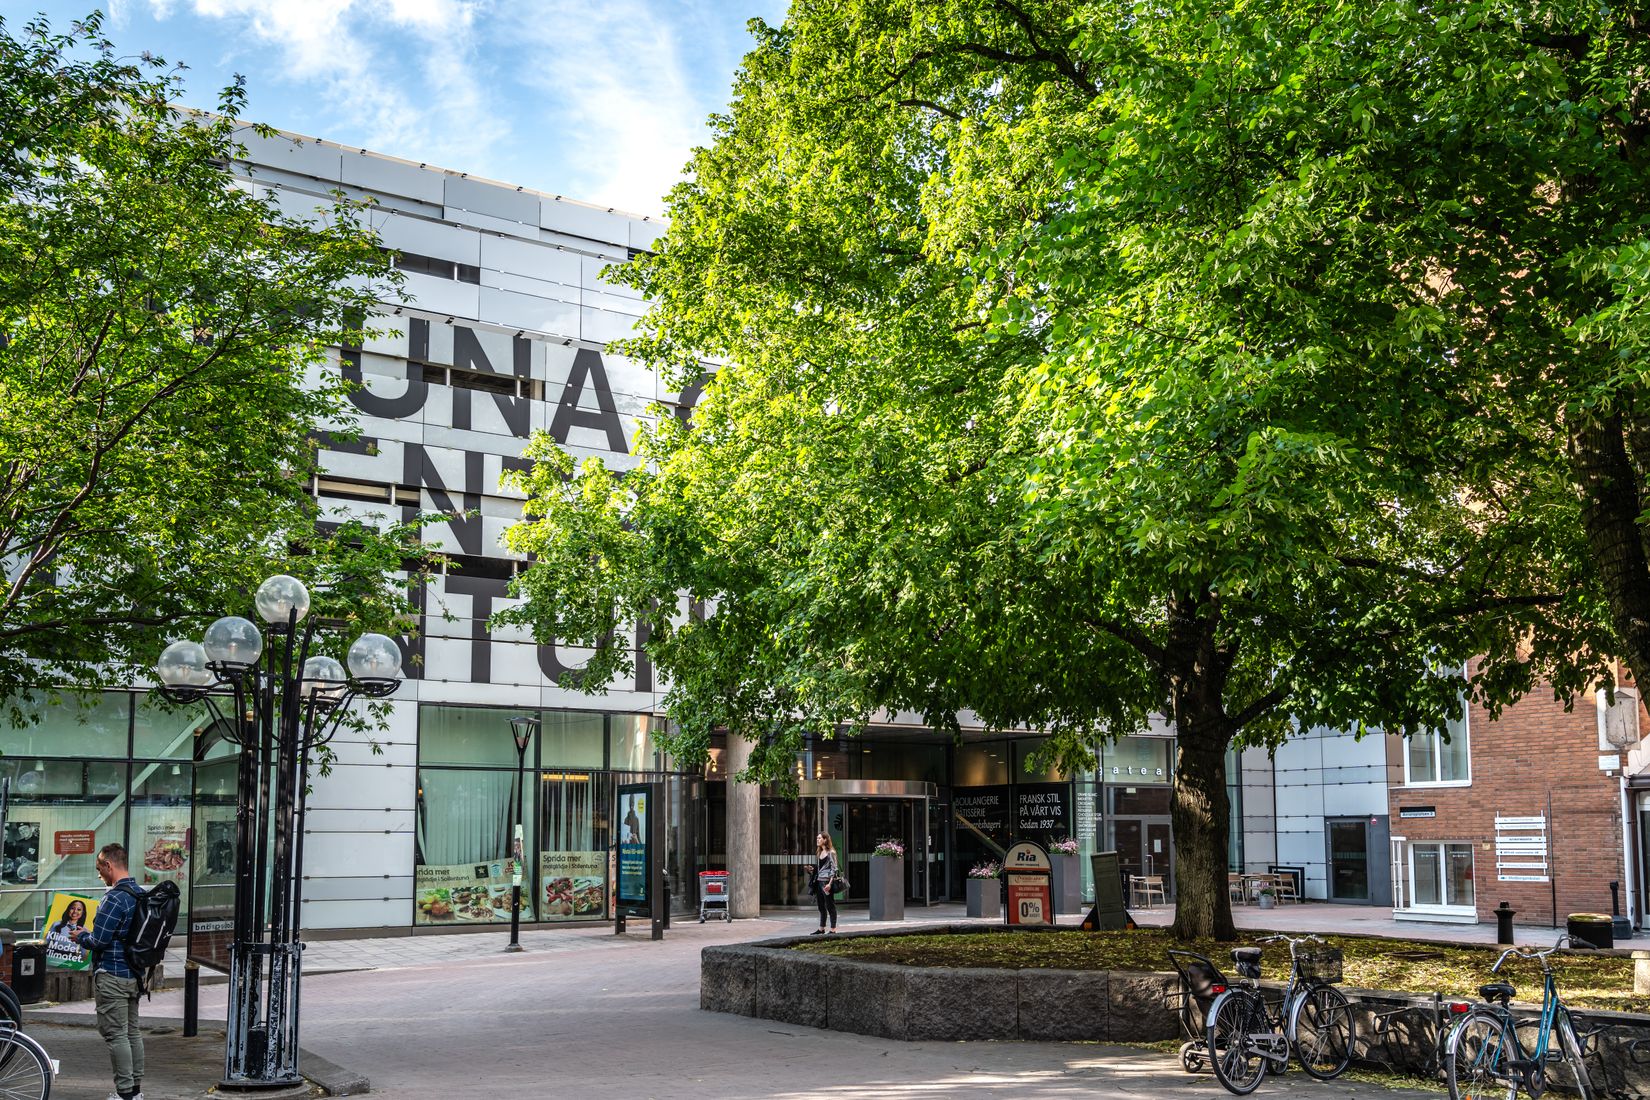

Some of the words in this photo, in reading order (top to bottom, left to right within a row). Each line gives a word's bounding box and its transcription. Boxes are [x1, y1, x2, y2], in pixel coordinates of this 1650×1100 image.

[1020, 794, 1045, 804] FRANSK
[1047, 793, 1061, 803] STIL
[1020, 806, 1029, 816] PÅ
[1031, 806, 1048, 816] VÅRT
[1050, 805, 1062, 816] VIS
[1020, 819, 1039, 829] Sedan
[1040, 819, 1055, 829] 1937
[543, 854, 566, 864] Sprida
[1017, 849, 1037, 862] Ria
[1021, 902, 1040, 918] 0%
[48, 940, 82, 954] Modet.
